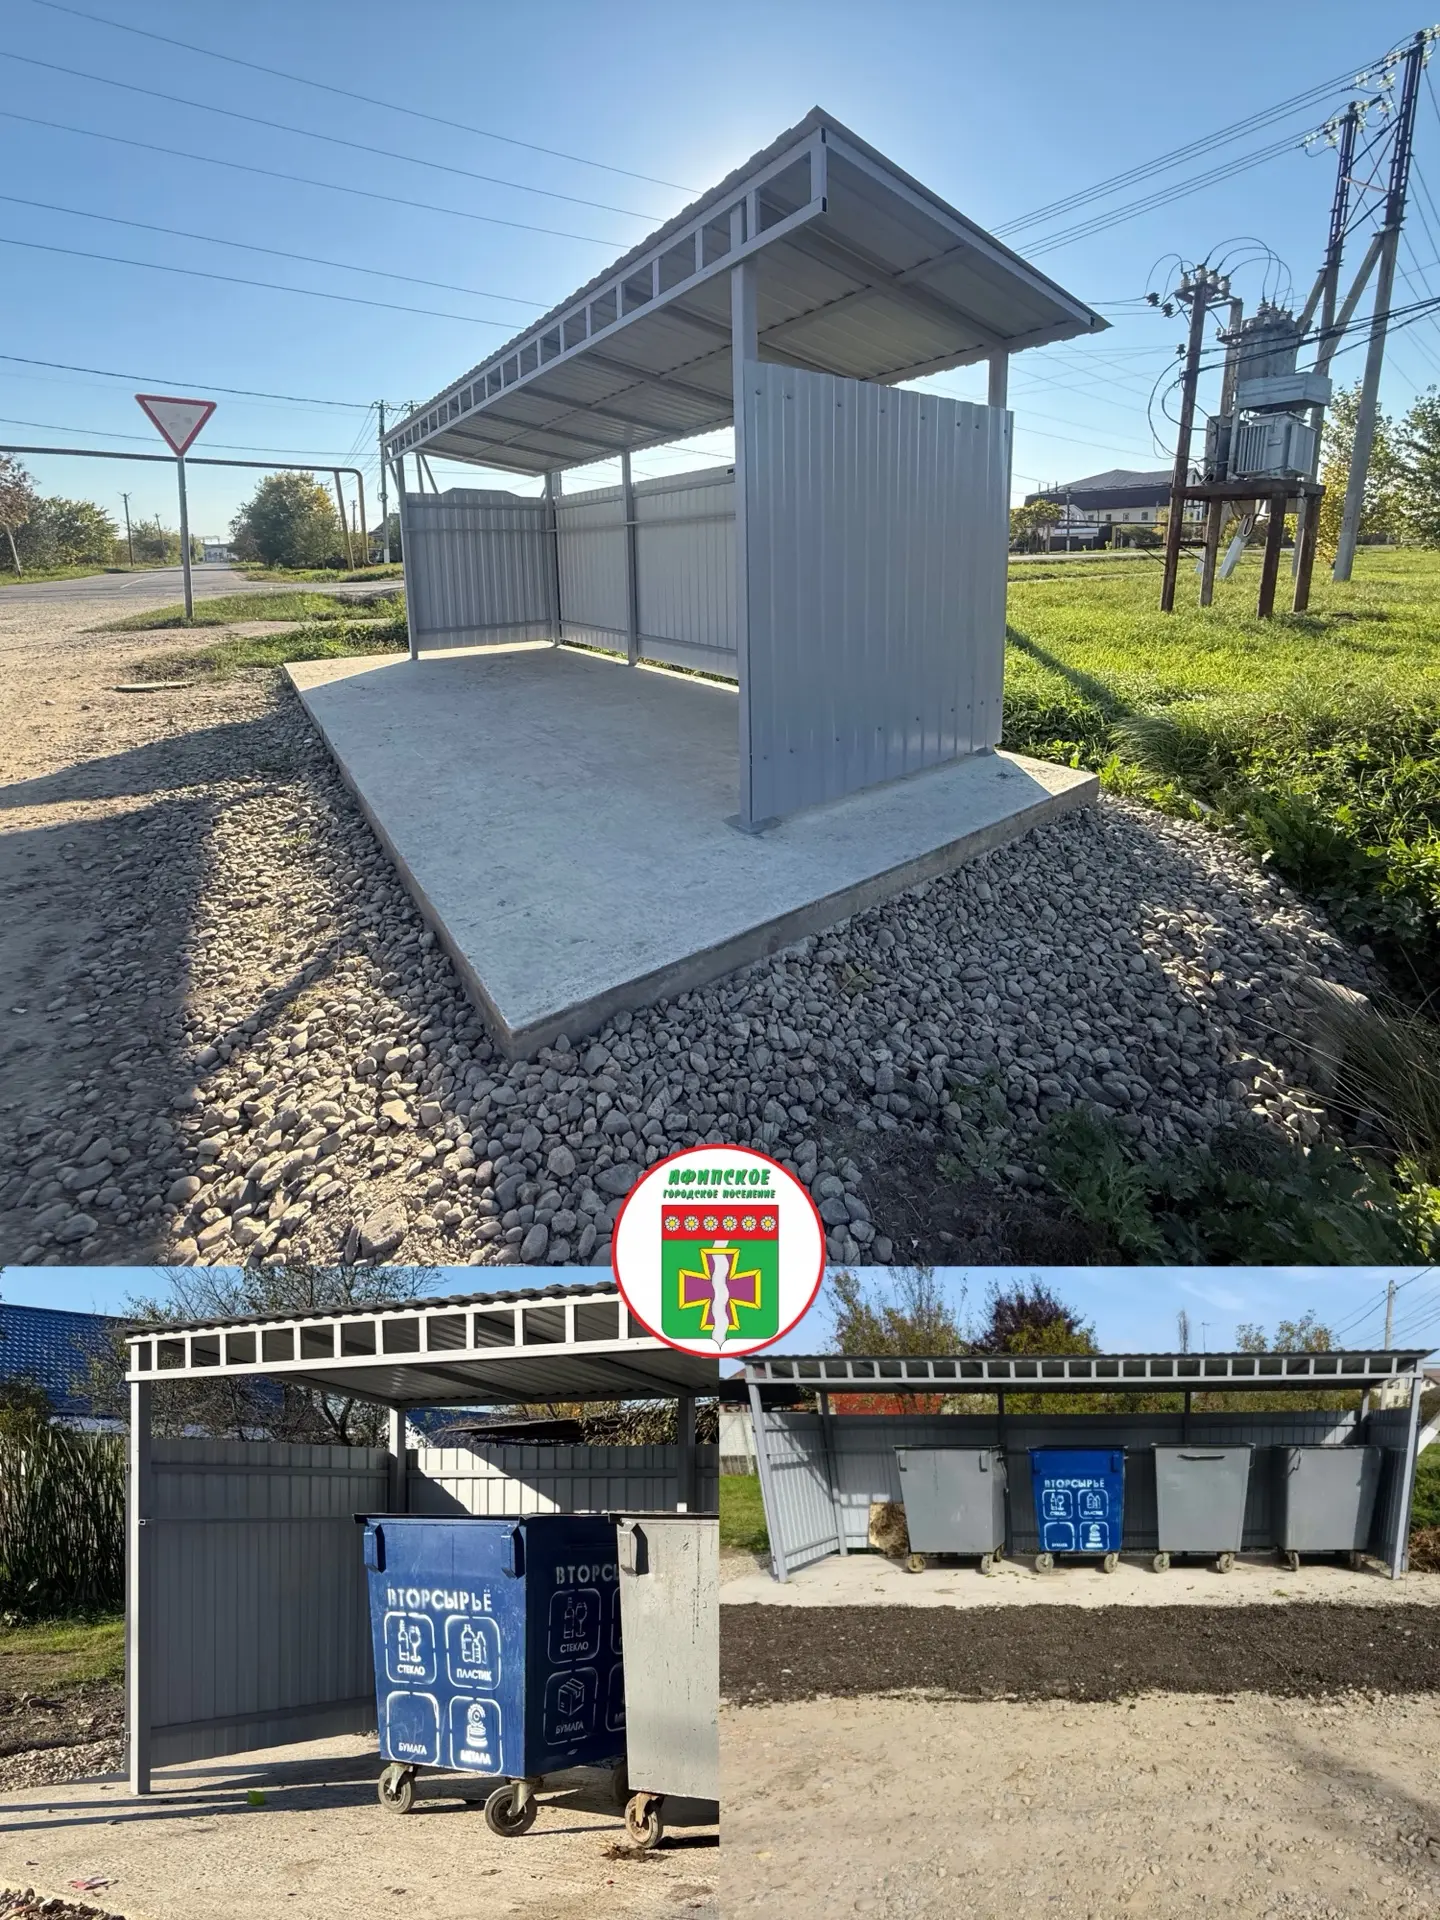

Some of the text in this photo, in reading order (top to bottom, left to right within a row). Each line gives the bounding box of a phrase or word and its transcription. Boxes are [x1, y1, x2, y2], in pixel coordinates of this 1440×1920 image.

[387, 1588, 493, 1612] ВТОРСЫРЬЁ
[560, 1641, 590, 1653] СТЕКЛО
[397, 1664, 426, 1676] СТЕКЛО
[456, 1668, 493, 1682] ПЛАСТИК
[555, 1720, 585, 1735] БУМАГА
[398, 1742, 428, 1755] БУМАГА
[460, 1749, 492, 1765] МЕТАЛЛ
